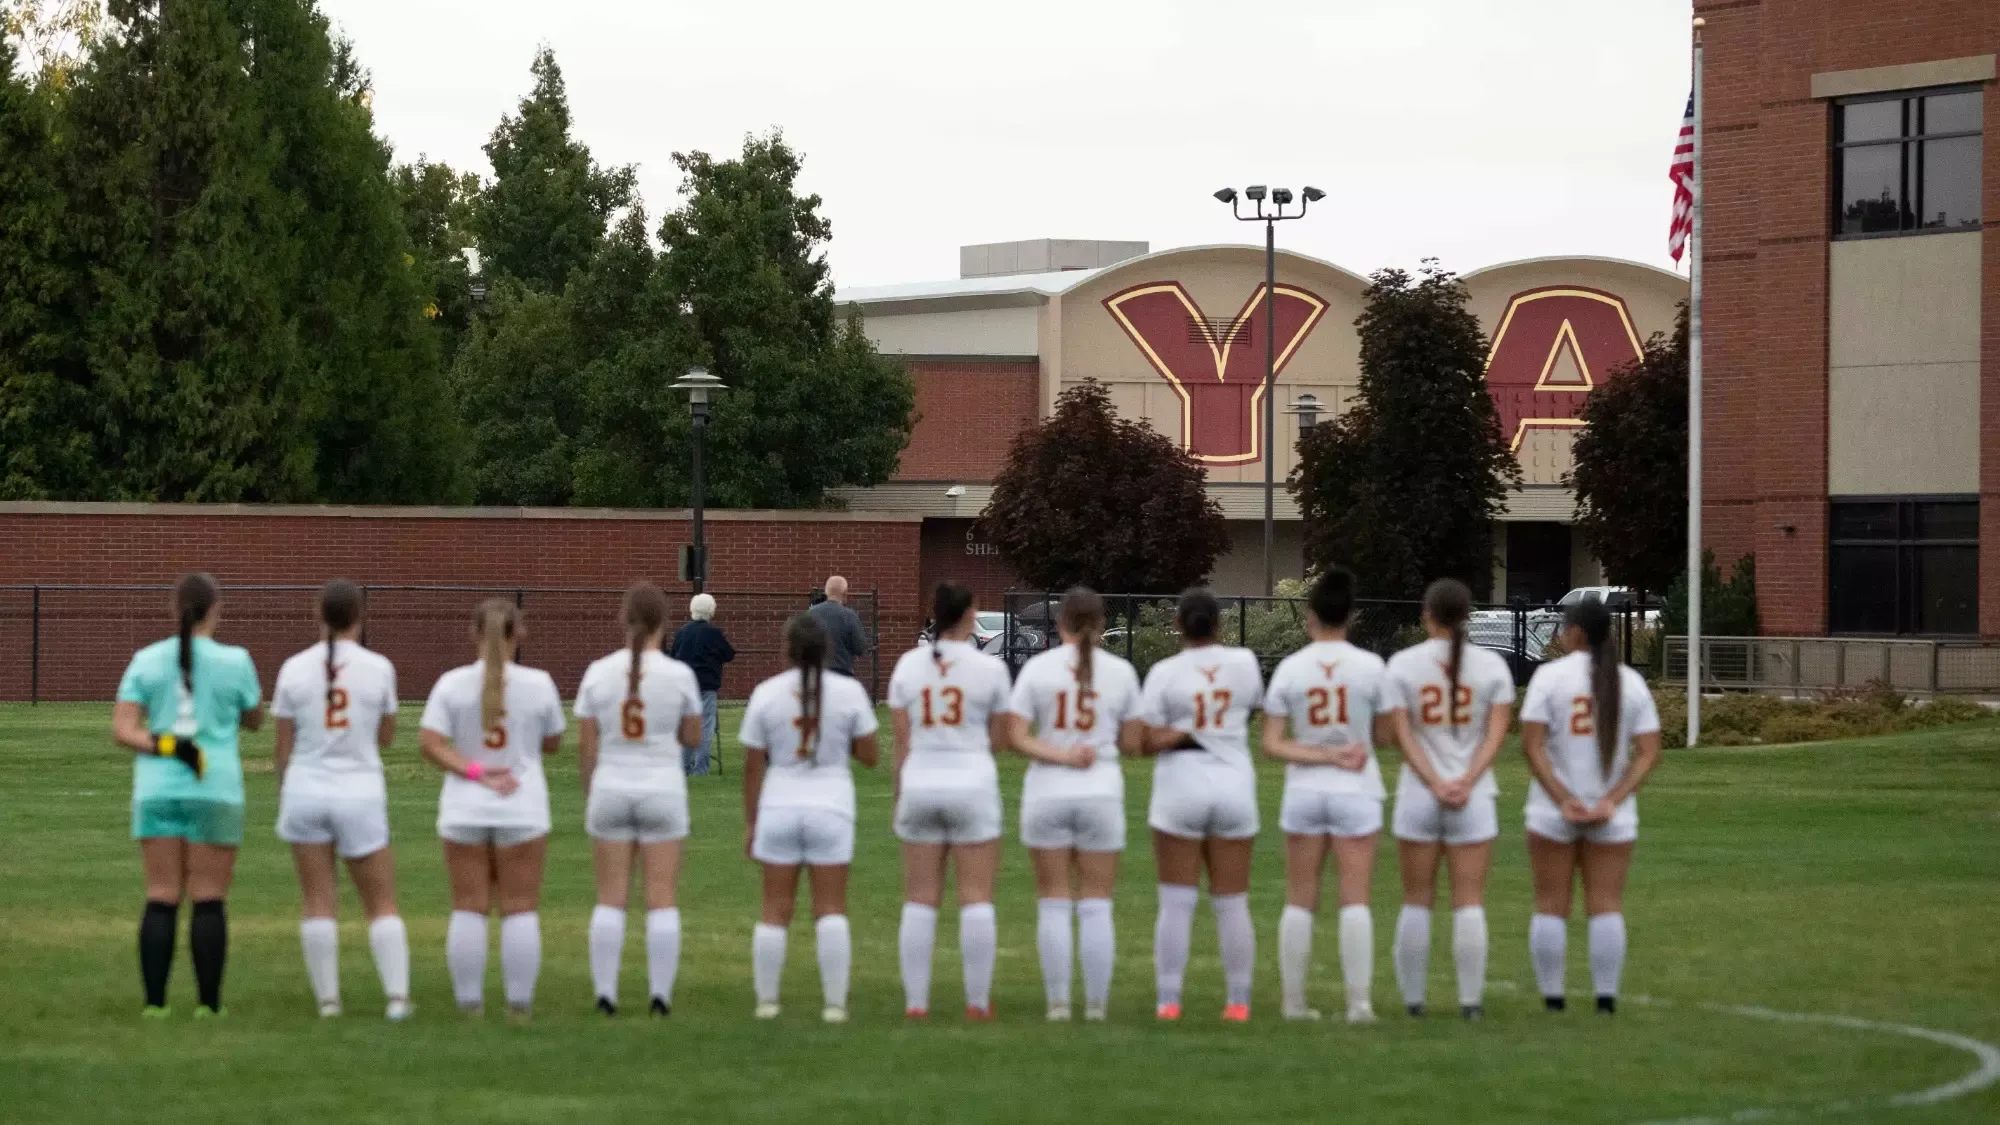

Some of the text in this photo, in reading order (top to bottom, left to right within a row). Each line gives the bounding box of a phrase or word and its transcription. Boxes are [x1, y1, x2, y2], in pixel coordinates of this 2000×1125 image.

[966, 543, 999, 555] SHE
[324, 687, 350, 729] 2
[621, 699, 646, 740] 6
[920, 684, 965, 727] 13
[1053, 690, 1097, 731] 15
[1193, 689, 1232, 730] 17
[1305, 684, 1349, 727] 21
[1419, 684, 1472, 725] 22
